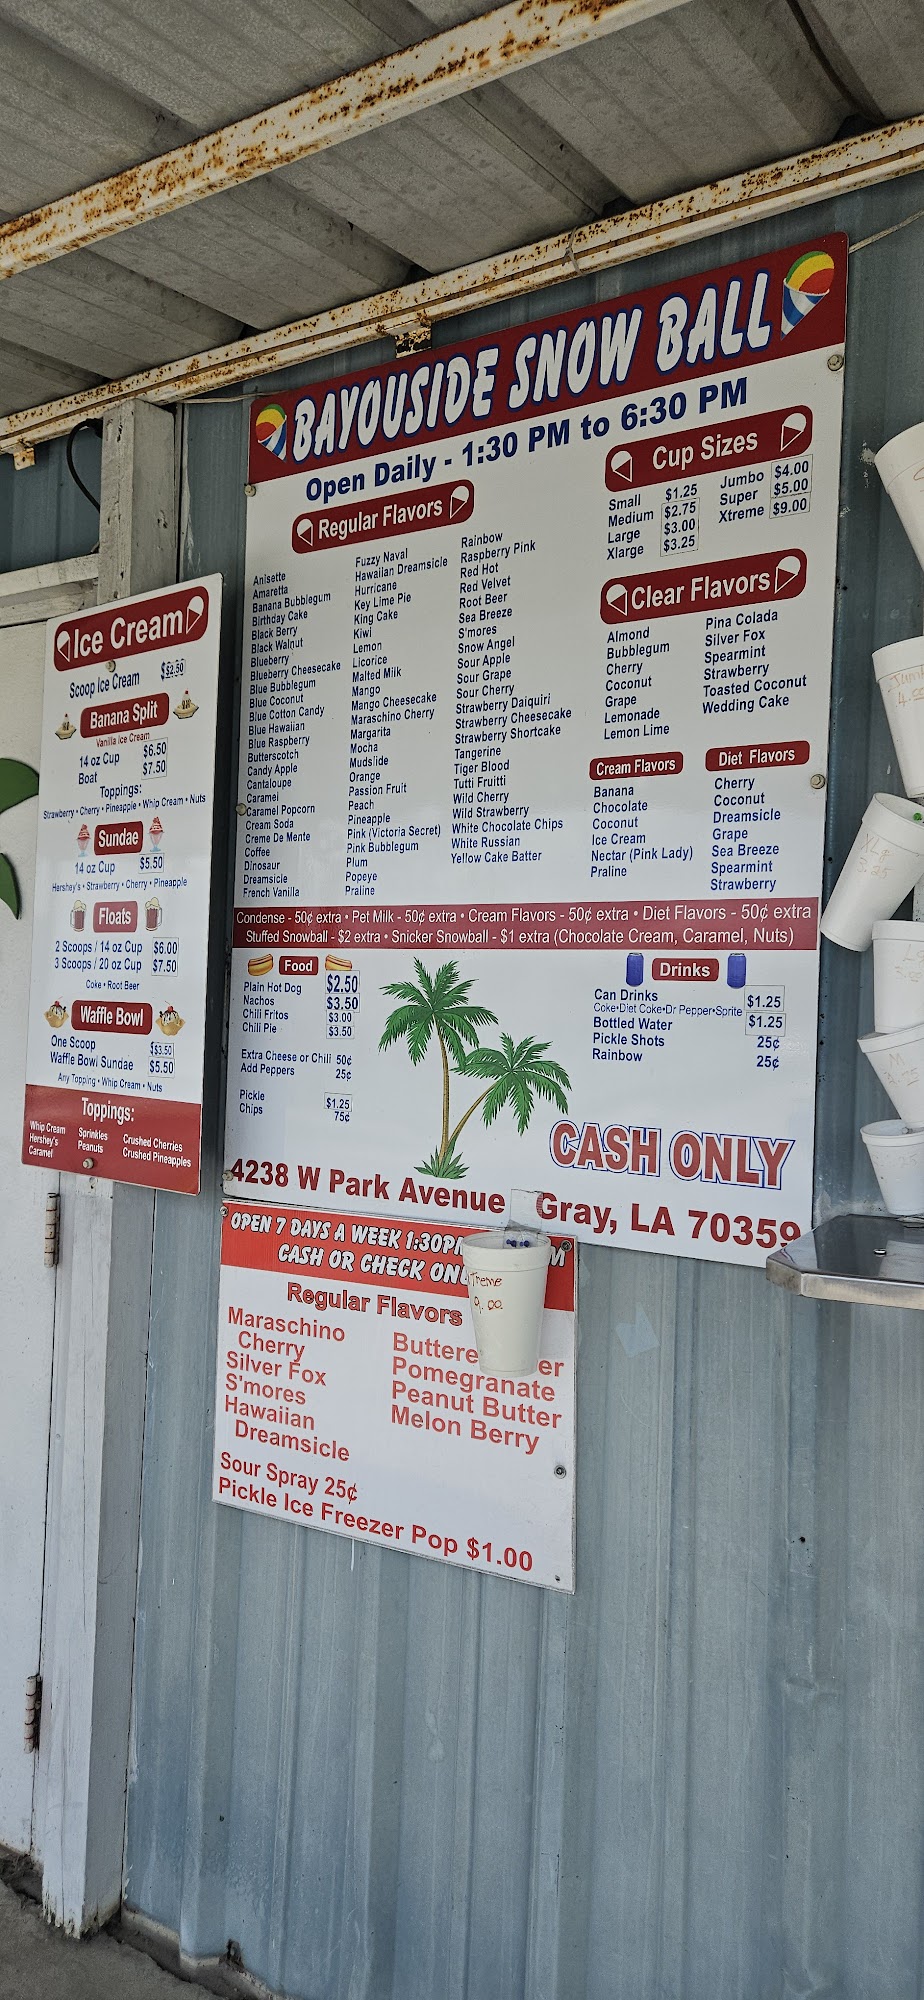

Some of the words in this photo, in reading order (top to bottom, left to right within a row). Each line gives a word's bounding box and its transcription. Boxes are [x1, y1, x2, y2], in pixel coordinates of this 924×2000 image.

[292, 347, 499, 463] BAYOUSIDE
[507, 307, 643, 410] SNOW
[656, 271, 771, 373] BALL
[306, 473, 365, 504] Open
[374, 454, 436, 487] Daily
[463, 432, 517, 466] 1:30
[529, 419, 570, 452] PM
[581, 414, 610, 440] to
[621, 392, 686, 430] 6:30
[699, 377, 747, 414] PM
[653, 446, 694, 470] Cup
[700, 432, 757, 460] Sizes
[720, 471, 764, 488] Jumbo
[775, 461, 809, 479] $4.00
[608, 494, 641, 511] Small
[665, 483, 697, 501] $1.25
[720, 488, 758, 506] Super
[774, 479, 808, 496] $5.00
[319, 511, 378, 540] Regular
[383, 500, 442, 526] Flavors
[608, 510, 654, 527] Medium
[664, 502, 696, 519] $2.75
[719, 505, 764, 523] Xtreme
[773, 498, 807, 516] $9.00
[461, 533, 503, 548] Rainbow
[461, 546, 510, 563] Raspberry
[514, 540, 535, 554] Pink
[355, 555, 380, 568] Fuzzy
[383, 548, 408, 562] Naval
[253, 572, 286, 586] Anisette
[460, 580, 478, 594] Red
[481, 575, 511, 590] Velvet
[632, 585, 684, 610] Clear
[691, 572, 770, 601] Flavors
[706, 617, 731, 629] Pina
[736, 609, 778, 626] Colada
[73, 629, 103, 658] Ice
[110, 609, 183, 649] Cream
[252, 628, 273, 640] Black
[276, 626, 298, 637] Berry
[458, 625, 497, 639] S'mores
[607, 627, 650, 643] Almond
[607, 641, 670, 659] Bubblegum
[704, 645, 766, 665] Spearmint
[90, 708, 130, 729] Banana
[133, 703, 158, 725] Split
[80, 755, 89, 767] 14
[91, 755, 100, 765] oz
[103, 752, 119, 766] Cup
[143, 742, 166, 758] $6.50
[248, 749, 299, 762] Butterscotch
[719, 751, 742, 766] Diet
[750, 748, 795, 764] Flavors
[454, 762, 478, 776] Tiger
[481, 760, 510, 772] Blood
[596, 761, 631, 776] Cream
[634, 758, 676, 773] Flavors
[100, 783, 142, 799] Toppings:
[349, 785, 383, 796] Passion
[386, 783, 407, 794] Fruit
[593, 800, 648, 813] Chocolate
[713, 808, 781, 823] Dreamsicle
[98, 828, 138, 847] Sundae
[452, 837, 478, 849] White
[481, 837, 520, 848] Russian
[244, 874, 288, 885] Dreamsicle
[99, 908, 131, 925] Floats
[246, 930, 279, 943] Stuffed
[282, 930, 328, 943] Snowball
[338, 930, 351, 944] $2
[354, 931, 381, 943] extra
[391, 929, 433, 944] Snicker
[436, 929, 488, 943] Snowball
[500, 928, 515, 945] $1
[518, 930, 550, 944] extra
[553, 928, 624, 946] (Chocolate
[628, 928, 677, 946] Cream,
[683, 928, 748, 946] Caramel,
[753, 927, 794, 945] Nuts)
[284, 960, 313, 972] Food
[660, 963, 710, 978] Drinks
[243, 982, 265, 992] Plain
[267, 982, 282, 993] Hot
[284, 983, 301, 995] Dog
[327, 974, 358, 993] $2.50
[243, 996, 274, 1006] Nachos
[327, 997, 358, 1010] $3.50
[594, 989, 616, 1001] Can
[620, 990, 658, 1001] Drinks
[747, 996, 781, 1009] $1.25
[81, 1005, 112, 1024] Waffle
[116, 1007, 143, 1026] Bowl
[593, 1017, 635, 1030] Bottled
[638, 1018, 672, 1030] Water
[749, 1016, 783, 1029] $1.25
[82, 1097, 134, 1125] Toppings:
[239, 1103, 263, 1115] Chips
[334, 1111, 350, 1123] 75¢
[78, 1127, 108, 1141] Sprinkles
[550, 1120, 661, 1177] CASH
[670, 1130, 795, 1189] ONLY
[231, 1159, 289, 1187] 4238
[298, 1165, 320, 1190] W
[330, 1169, 389, 1200] Park
[399, 1177, 505, 1214] Avenue
[231, 1212, 272, 1234] OPEN
[276, 1217, 287, 1234] 7
[290, 1219, 331, 1241] DAYS
[334, 1223, 345, 1241] A
[352, 1224, 401, 1249] WEEK
[536, 1192, 617, 1235] Gray,
[631, 1203, 675, 1236] LA
[688, 1210, 801, 1248] 70359
[279, 1244, 324, 1266] CASH
[329, 1250, 355, 1271] OR
[360, 1254, 425, 1281] CHECK
[287, 1282, 370, 1312] Regular
[377, 1295, 463, 1327] Flavors
[228, 1306, 345, 1342] Maraschino
[238, 1331, 305, 1362] Cherry
[227, 1351, 282, 1377] Silver
[289, 1362, 326, 1386] Fox
[393, 1356, 555, 1401] Pomegranate
[225, 1373, 306, 1405] S'mores
[225, 1395, 314, 1430] Hawaiian
[392, 1380, 474, 1413] Peanut
[483, 1396, 562, 1428] Butter
[236, 1419, 349, 1461] Dreamsicle
[391, 1404, 461, 1436] Melon
[470, 1419, 539, 1455] Berry
[221, 1452, 261, 1477] Sour
[266, 1463, 319, 1496] Spray
[325, 1476, 358, 1504] 25¢
[219, 1477, 276, 1507] Pickle
[284, 1493, 314, 1516] Ice
[321, 1502, 404, 1540] Freezer
[412, 1524, 457, 1555] Pop
[467, 1537, 533, 1572] $1.00
